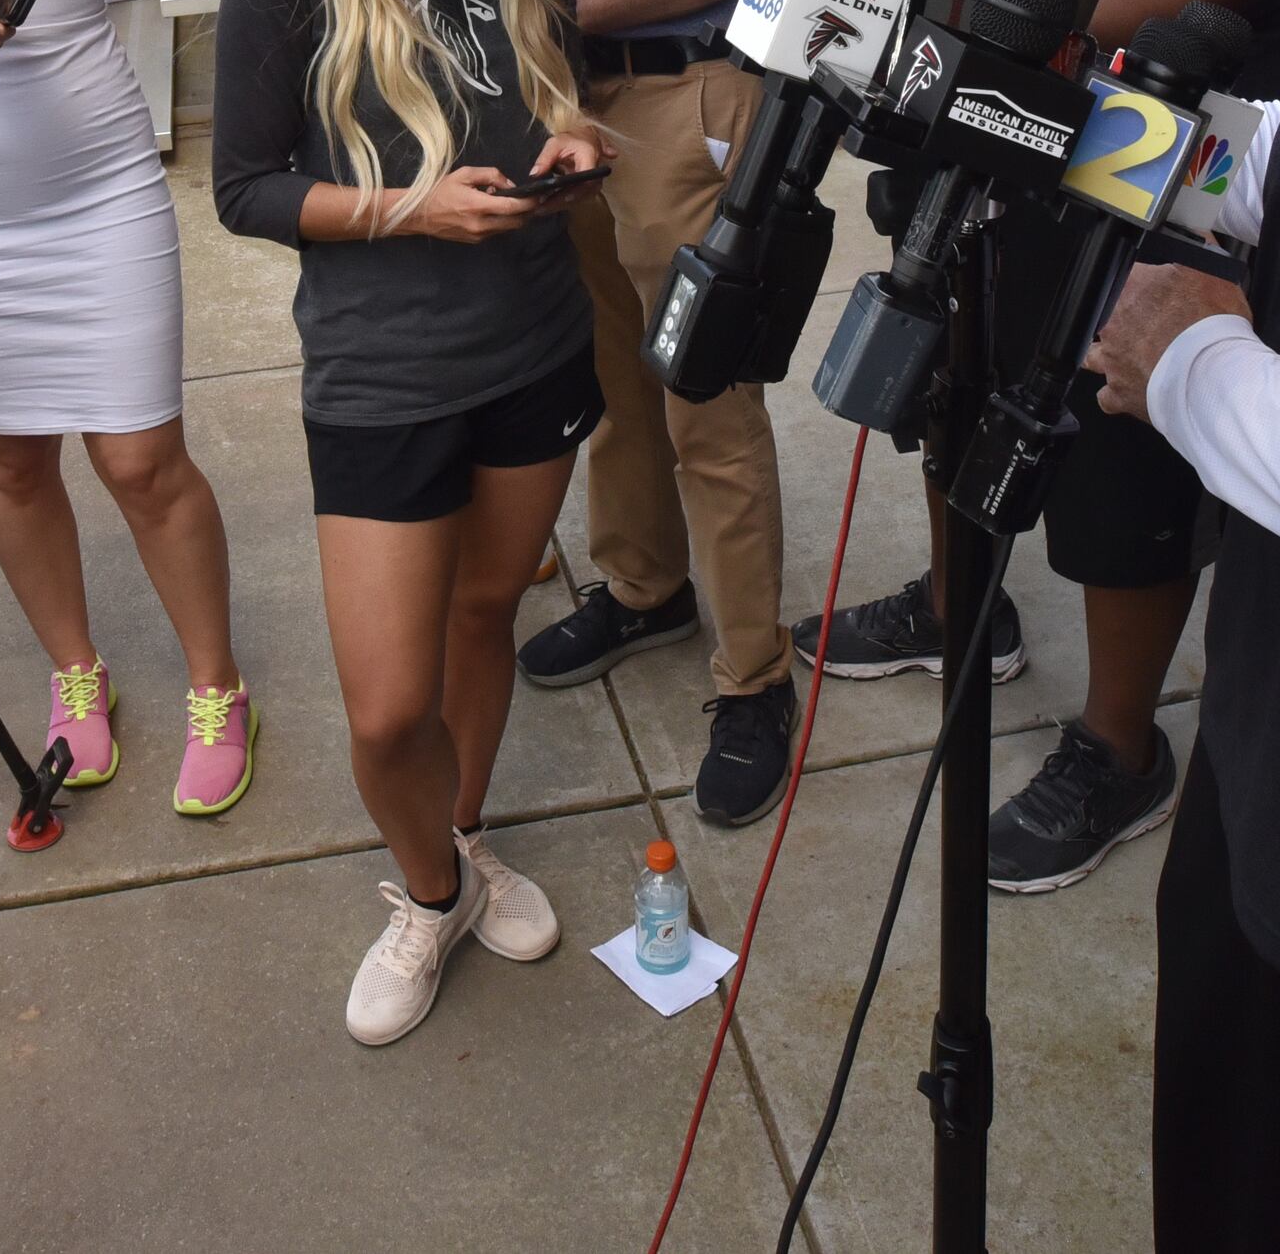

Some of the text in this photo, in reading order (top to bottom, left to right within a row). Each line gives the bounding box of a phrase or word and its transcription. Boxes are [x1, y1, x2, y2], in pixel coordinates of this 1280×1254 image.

[953, 95, 1069, 146] AMERICAN FAMILY
[958, 112, 1055, 153] INSURANCE
[1064, 92, 1178, 220] 2
